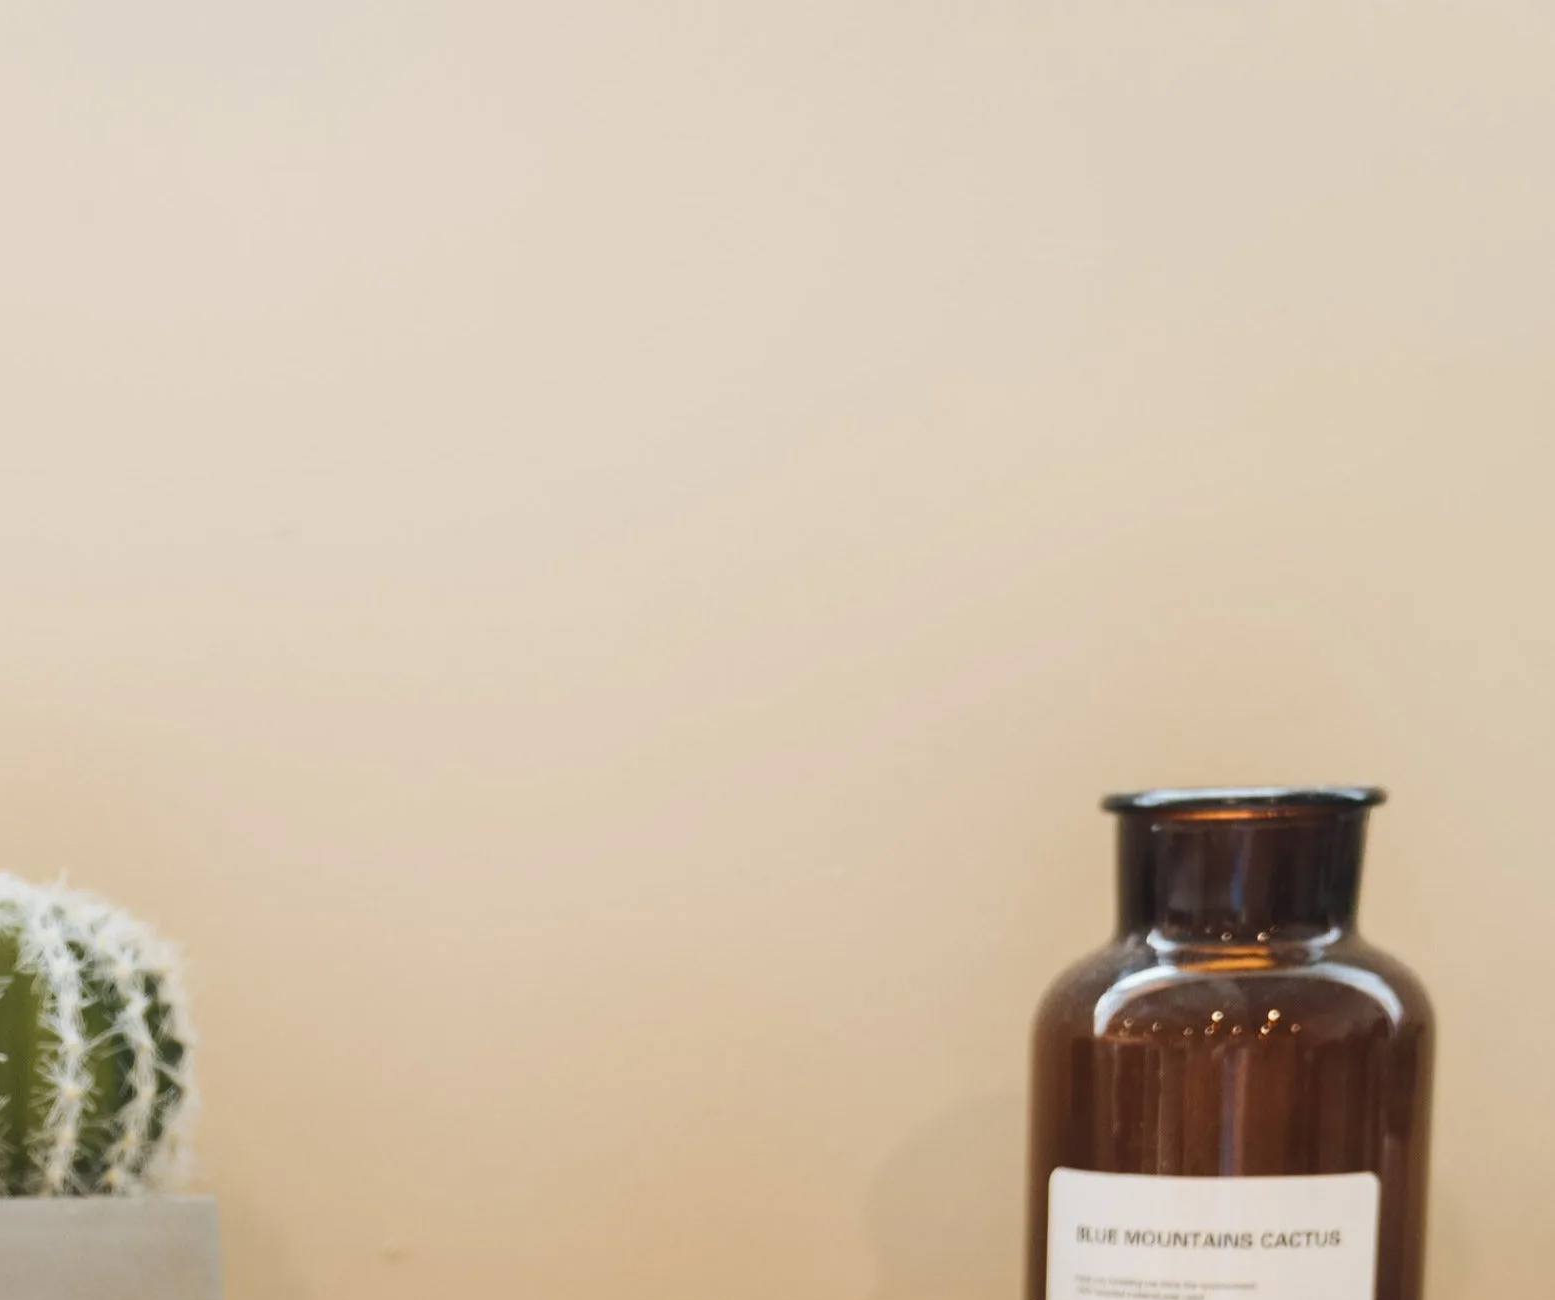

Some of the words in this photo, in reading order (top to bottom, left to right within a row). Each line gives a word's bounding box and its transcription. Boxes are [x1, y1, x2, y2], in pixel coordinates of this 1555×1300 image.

[1076, 1225, 1117, 1244] BLUE
[1124, 1229, 1253, 1249] MOUNTAINS
[1260, 1230, 1341, 1249] CACTUS
